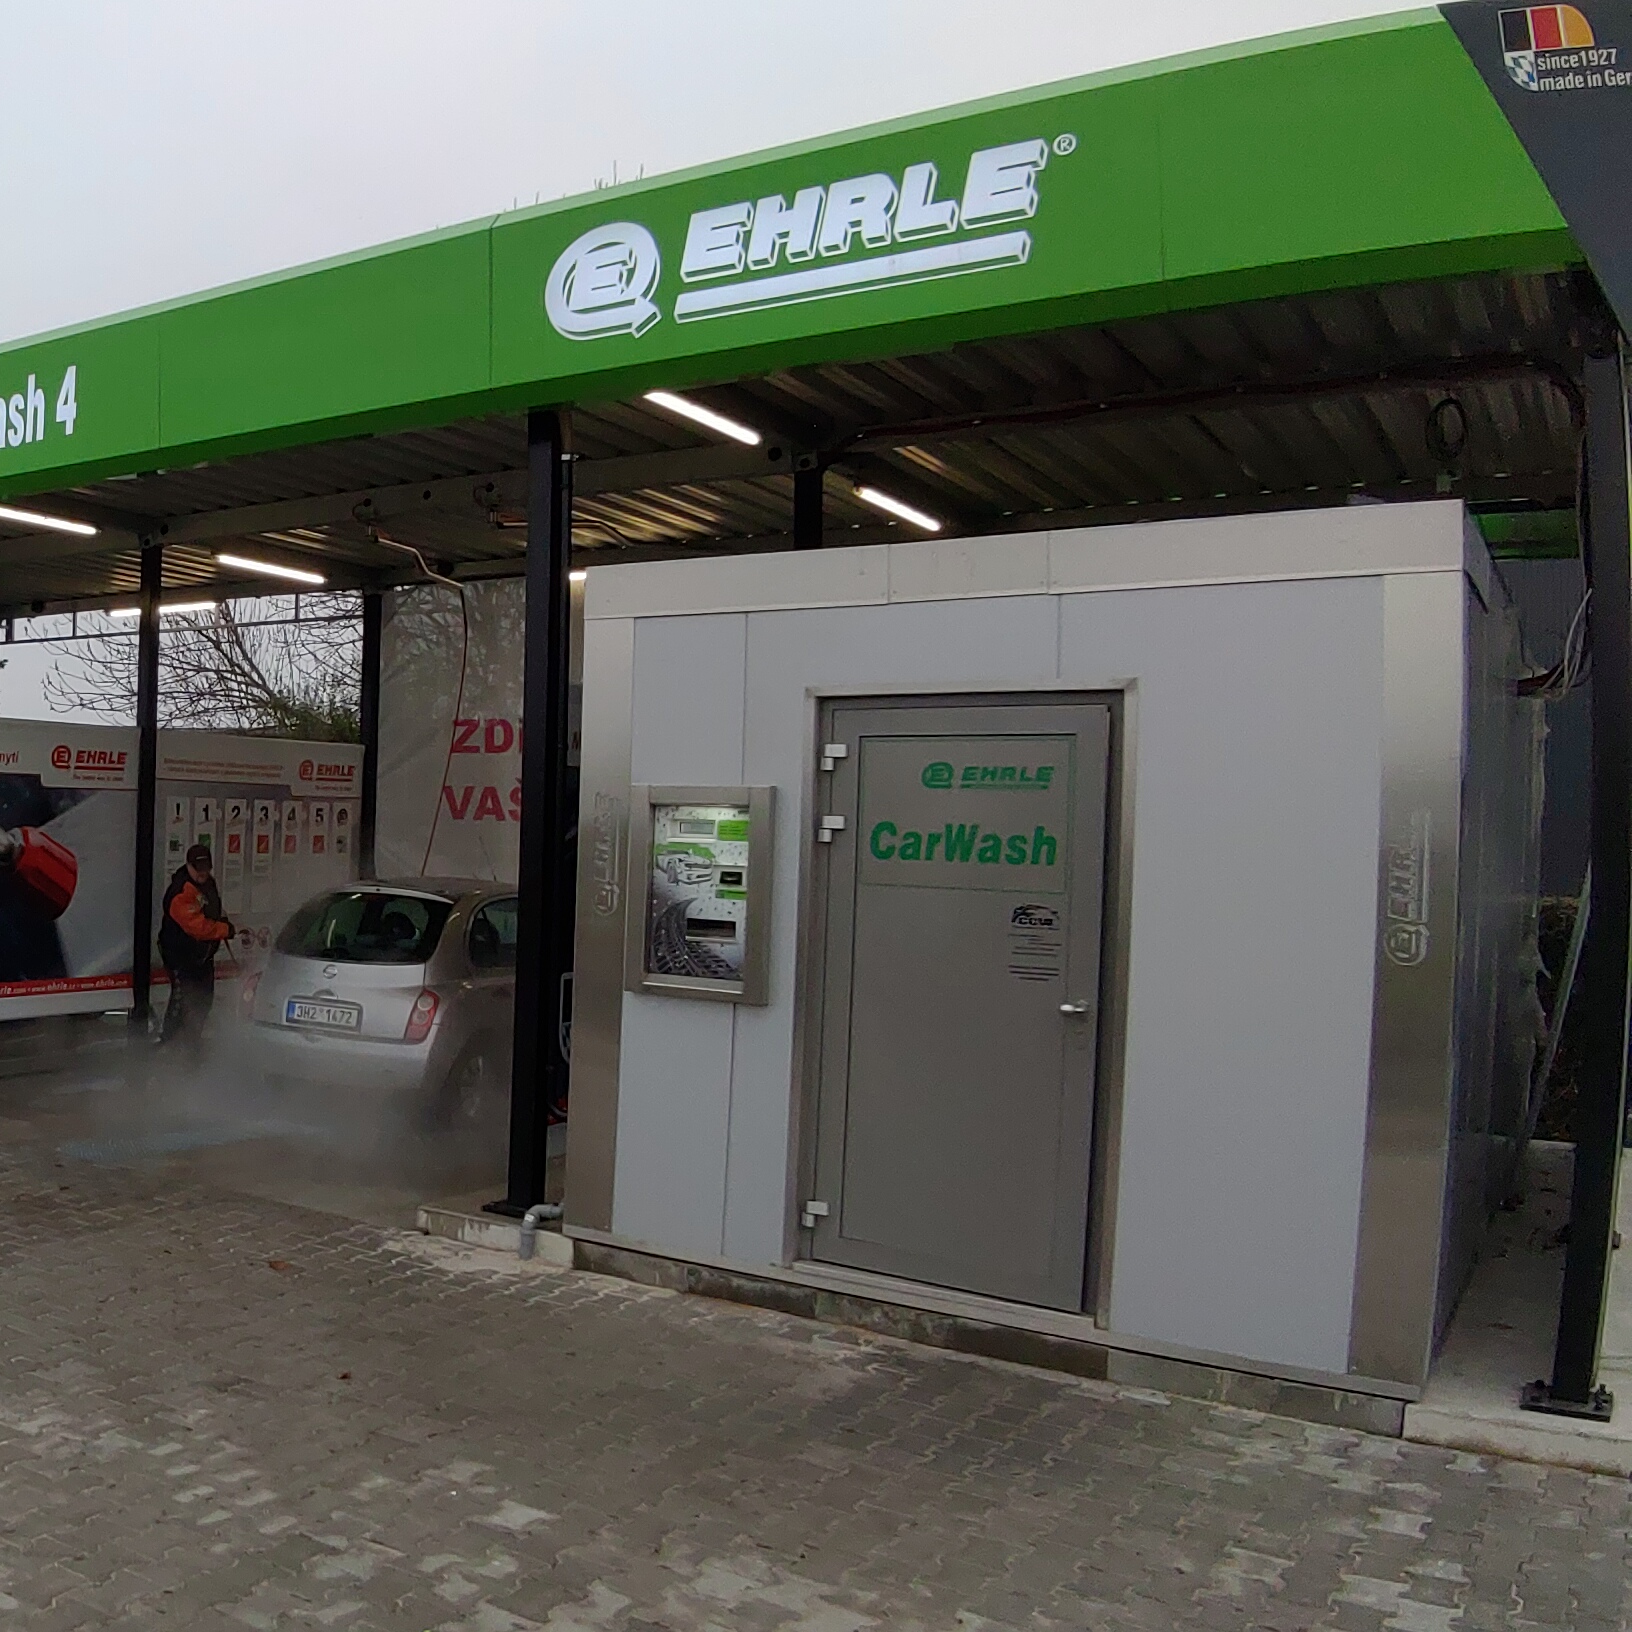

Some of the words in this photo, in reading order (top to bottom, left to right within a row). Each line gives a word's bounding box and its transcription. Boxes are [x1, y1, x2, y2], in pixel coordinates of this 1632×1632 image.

[1539, 72, 1585, 92] made
[1587, 71, 1602, 88] in
[55, 366, 78, 435] 4
[450, 718, 524, 754] ZD
[75, 750, 127, 765] EHRLE
[317, 764, 355, 776] EHRLE
[961, 765, 1055, 782] EHRLE
[202, 803, 210, 821] 1
[231, 805, 241, 820] 2
[259, 806, 269, 822] 3
[287, 806, 296, 821] 4
[315, 808, 324, 823] 5
[870, 821, 1057, 866] CarWash
[297, 1005, 317, 1020] 3H2
